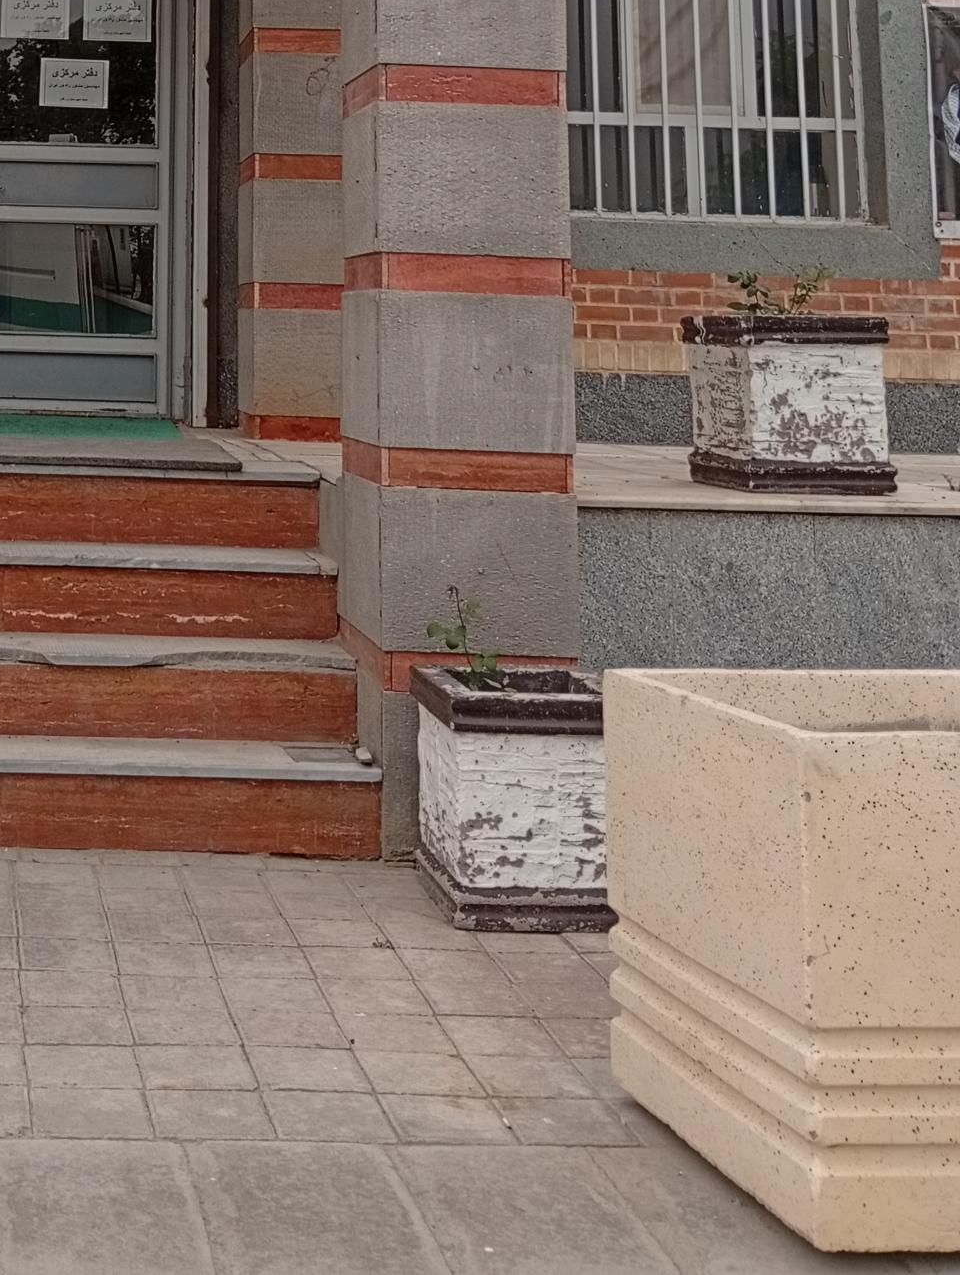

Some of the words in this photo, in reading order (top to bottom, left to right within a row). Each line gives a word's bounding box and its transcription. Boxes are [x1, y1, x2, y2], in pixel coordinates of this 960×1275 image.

[13, 0, 40, 10] مرکزی
[95, 2, 122, 12] مرکزی
[125, 0, 141, 12] دفتر
[52, 68, 79, 78] مرکزی
[81, 67, 98, 79] دفتر
